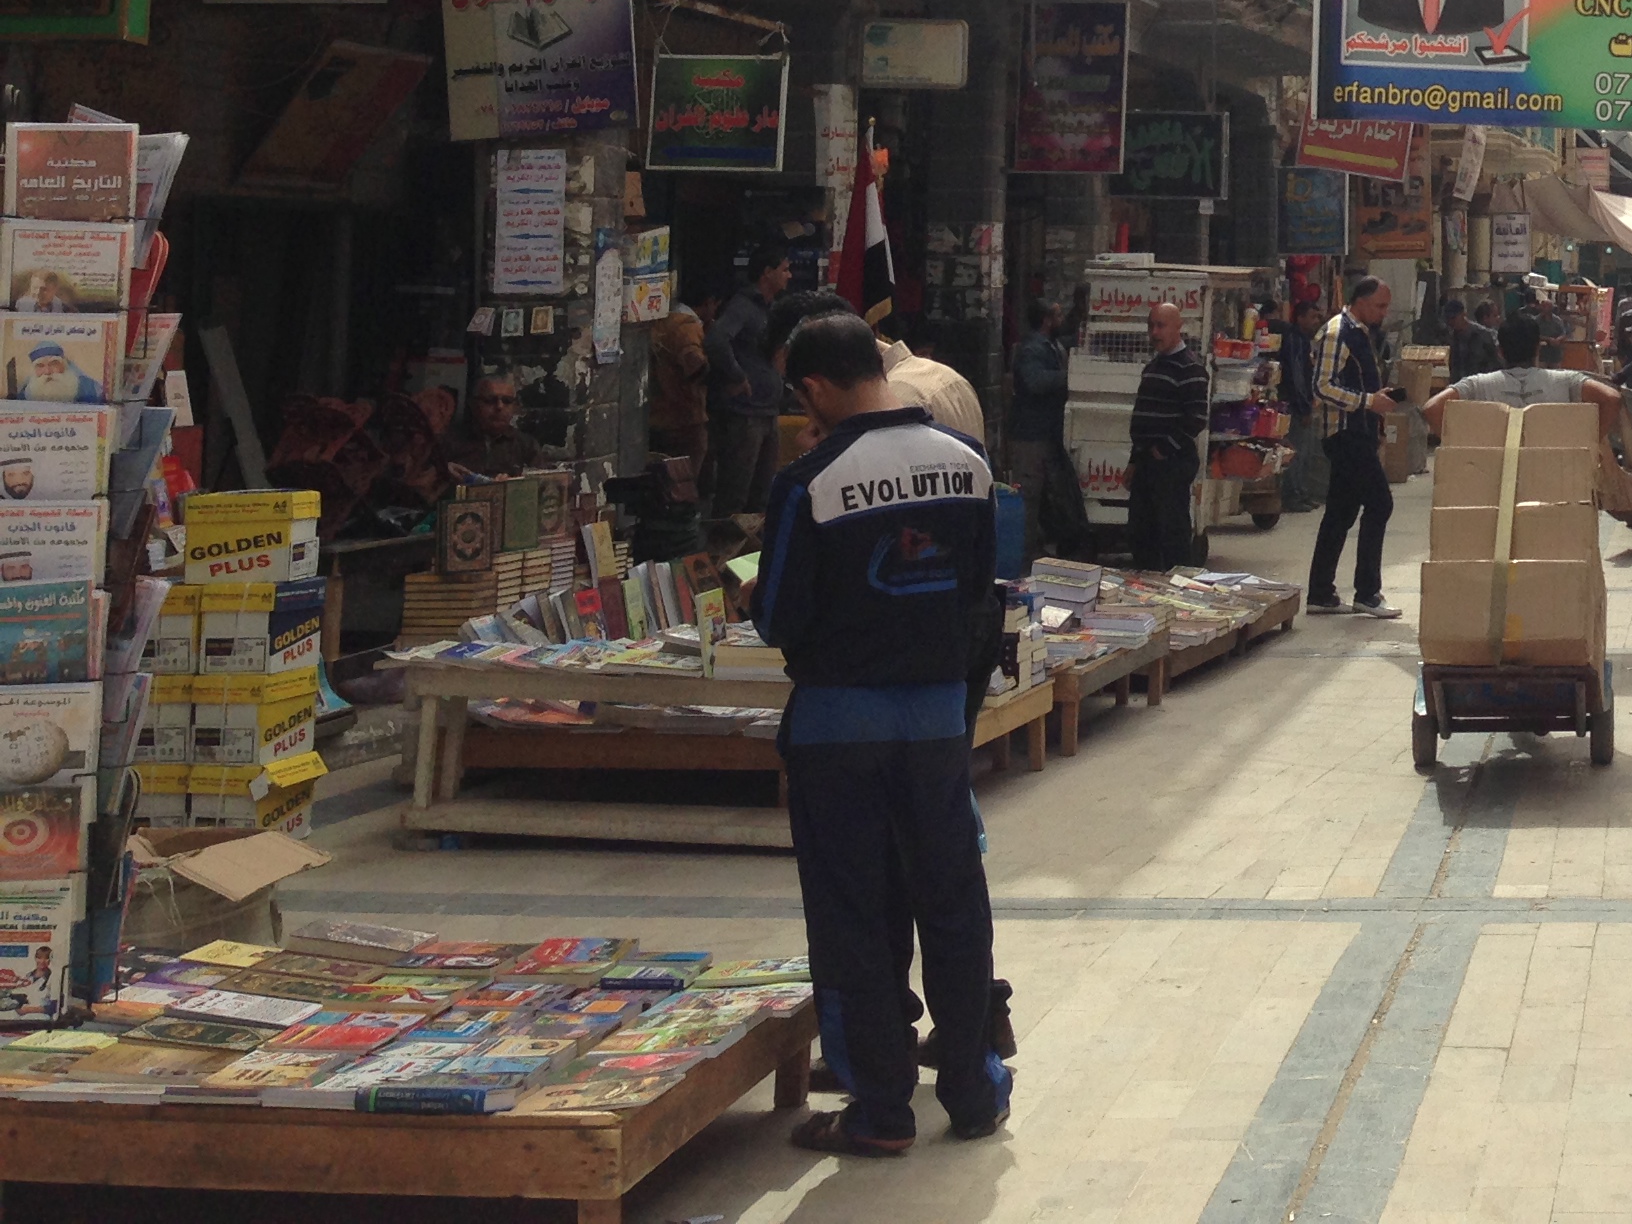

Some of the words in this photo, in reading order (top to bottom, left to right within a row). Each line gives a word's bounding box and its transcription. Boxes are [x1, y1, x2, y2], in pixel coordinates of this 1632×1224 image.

[1333, 83, 1563, 115] erfanbro@gmail.com
[840, 470, 975, 512] EVOLUTION
[190, 530, 283, 561] GOLDEN
[208, 554, 272, 577] PLUS
[273, 615, 320, 651] GOLDEN
[282, 638, 314, 666] PLUS
[263, 705, 313, 743] GOLDEN
[273, 728, 307, 757] PLUS
[262, 789, 311, 828] GOLDEN
